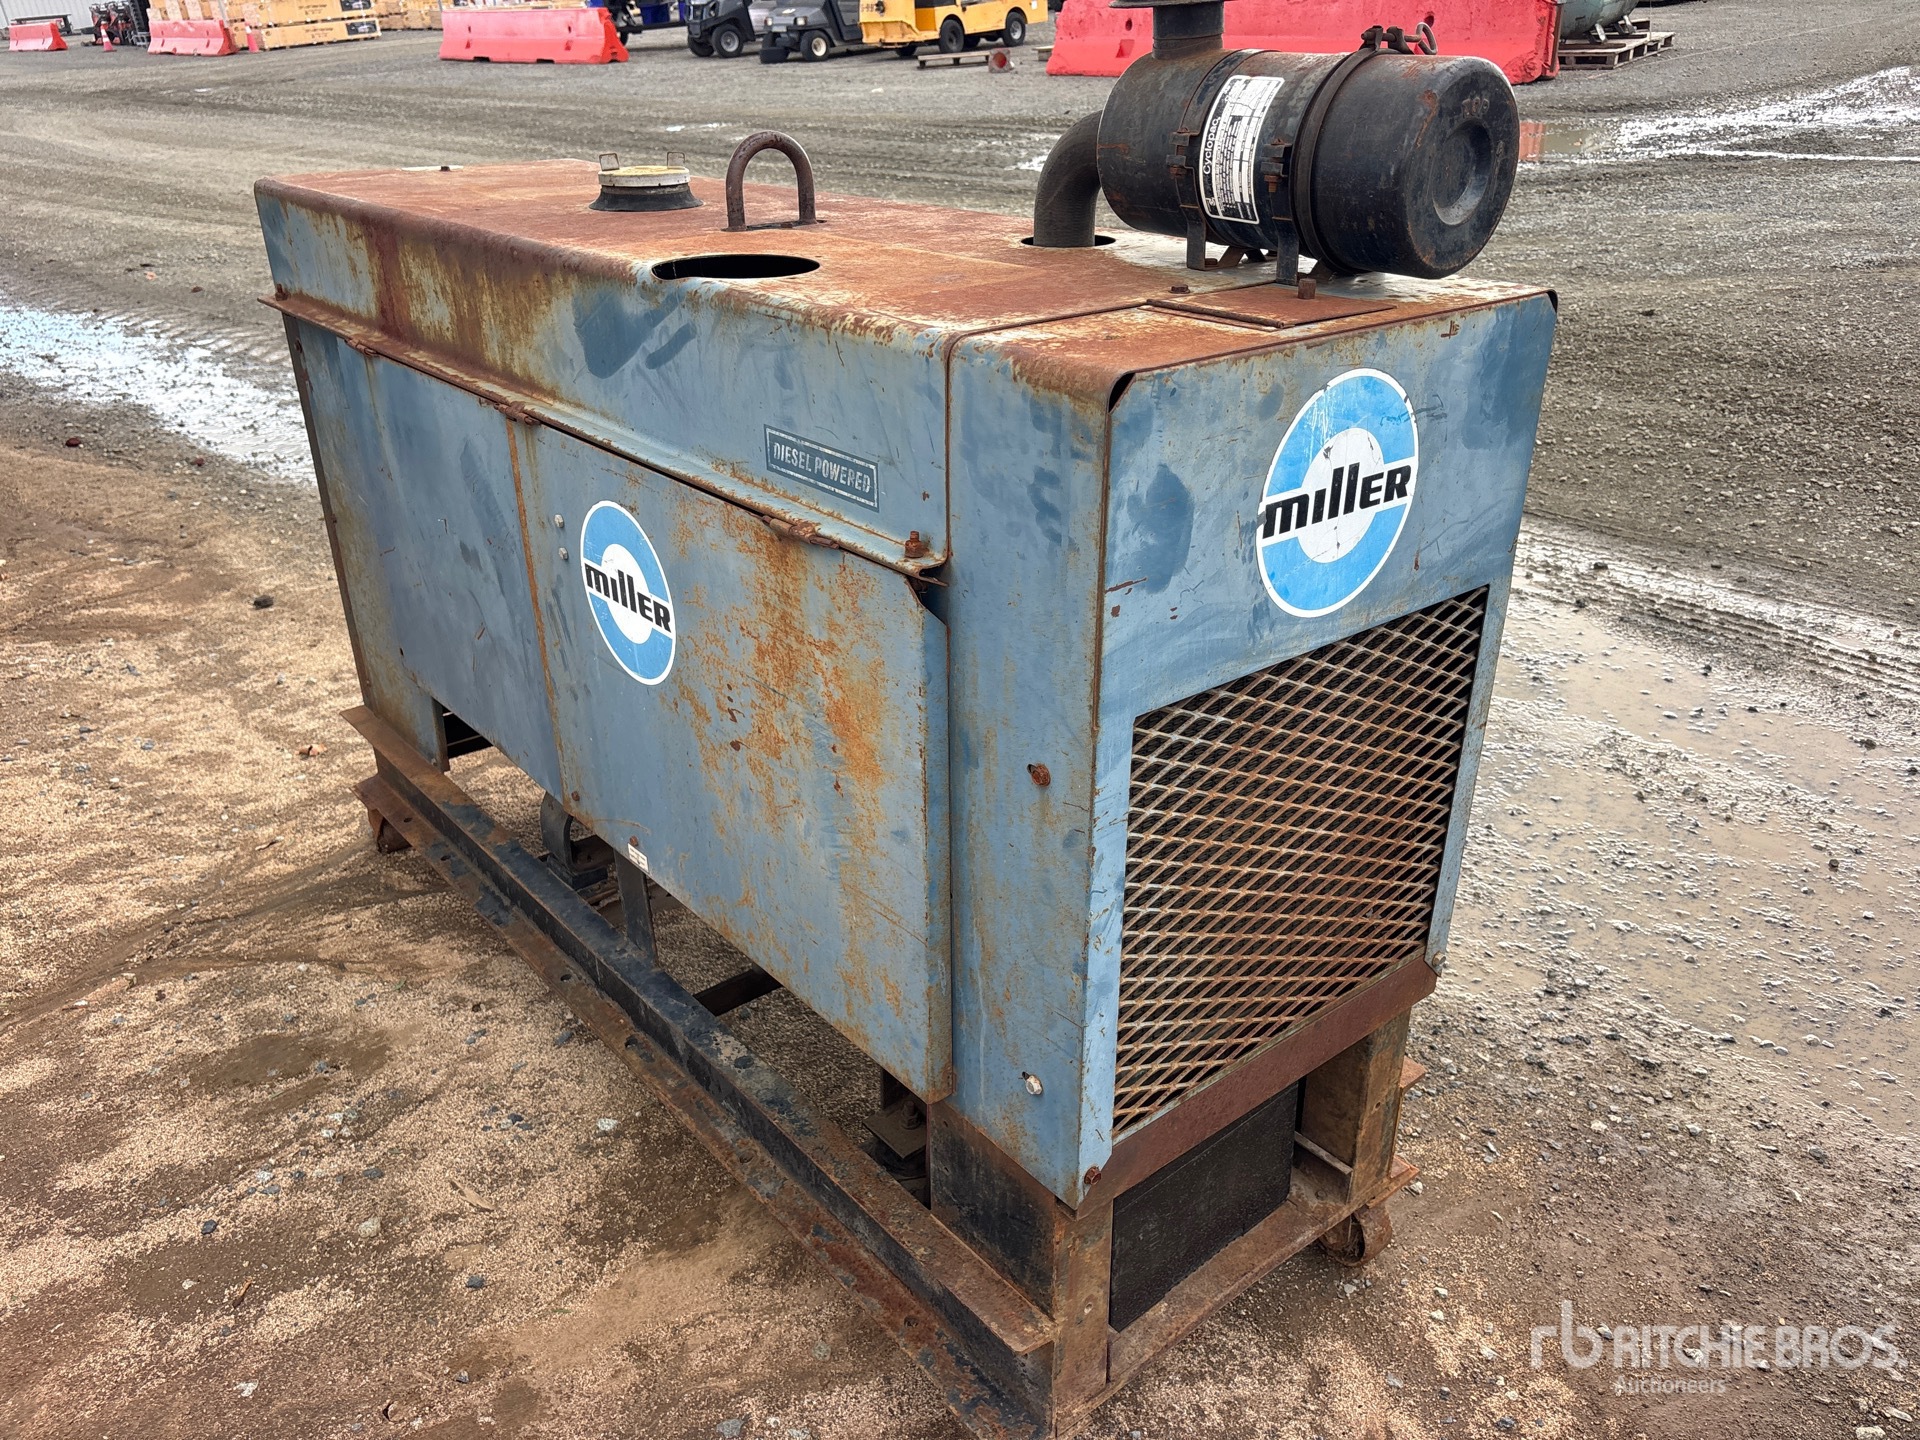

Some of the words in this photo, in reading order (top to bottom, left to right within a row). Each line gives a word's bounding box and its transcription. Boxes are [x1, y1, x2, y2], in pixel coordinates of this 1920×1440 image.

[1203, 117, 1220, 175] Cyclopac
[773, 442, 812, 472] DIESEL
[814, 456, 871, 493] POWERED
